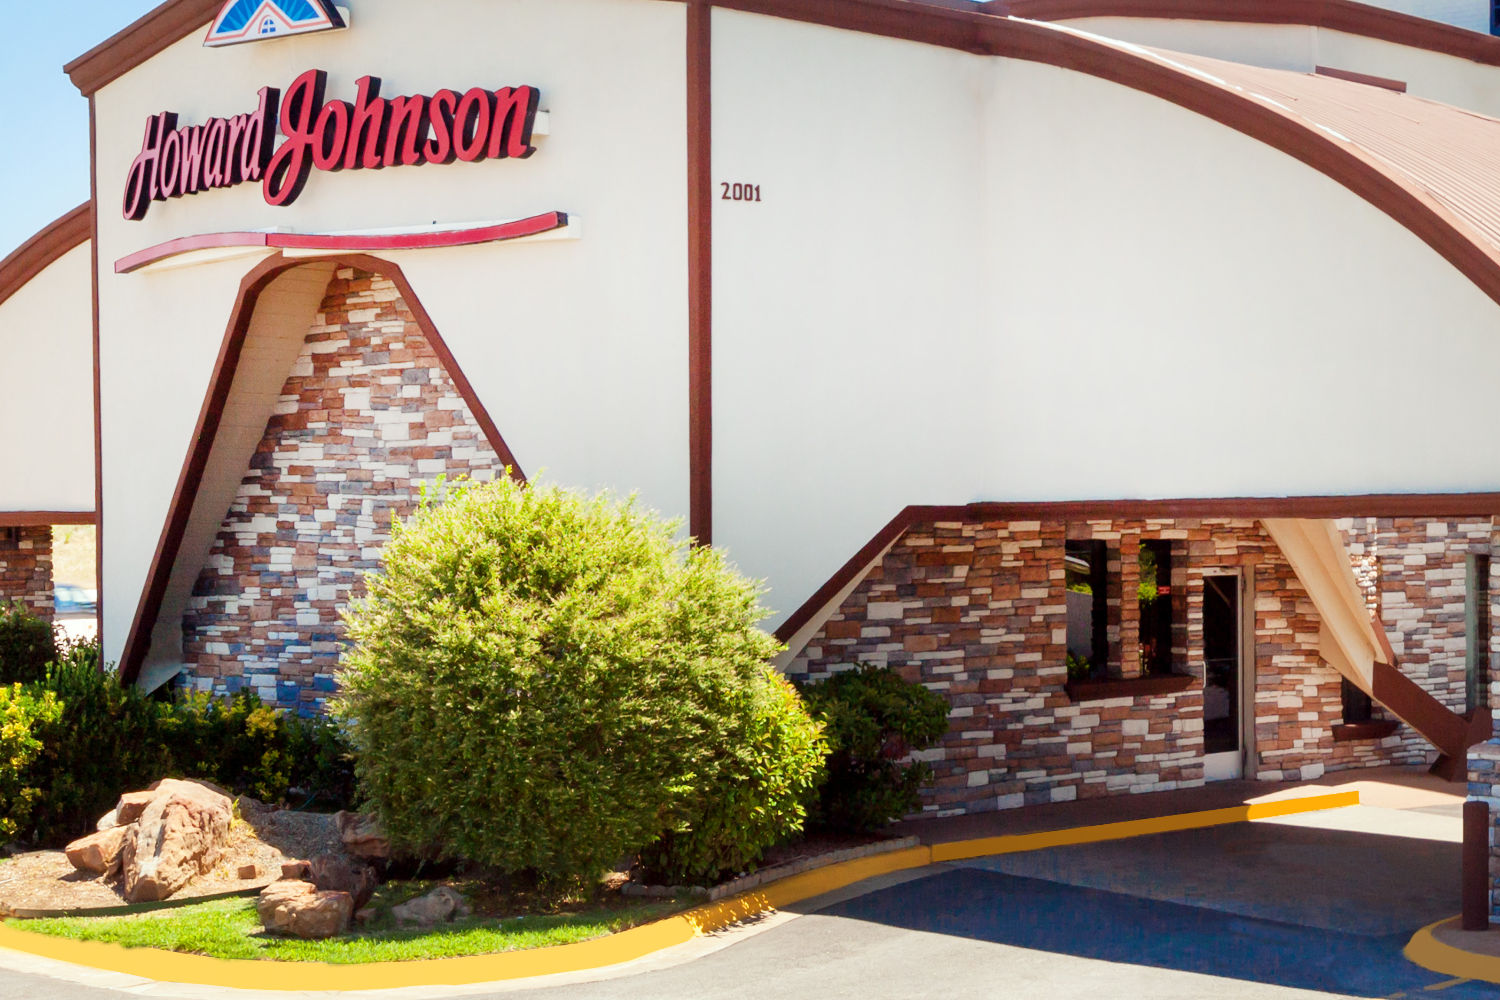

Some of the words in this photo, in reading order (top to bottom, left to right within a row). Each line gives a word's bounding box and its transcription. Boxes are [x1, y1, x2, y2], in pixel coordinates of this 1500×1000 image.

[122, 86, 280, 221] Howard
[263, 69, 540, 207] Johnson
[720, 182, 762, 202] 2001
